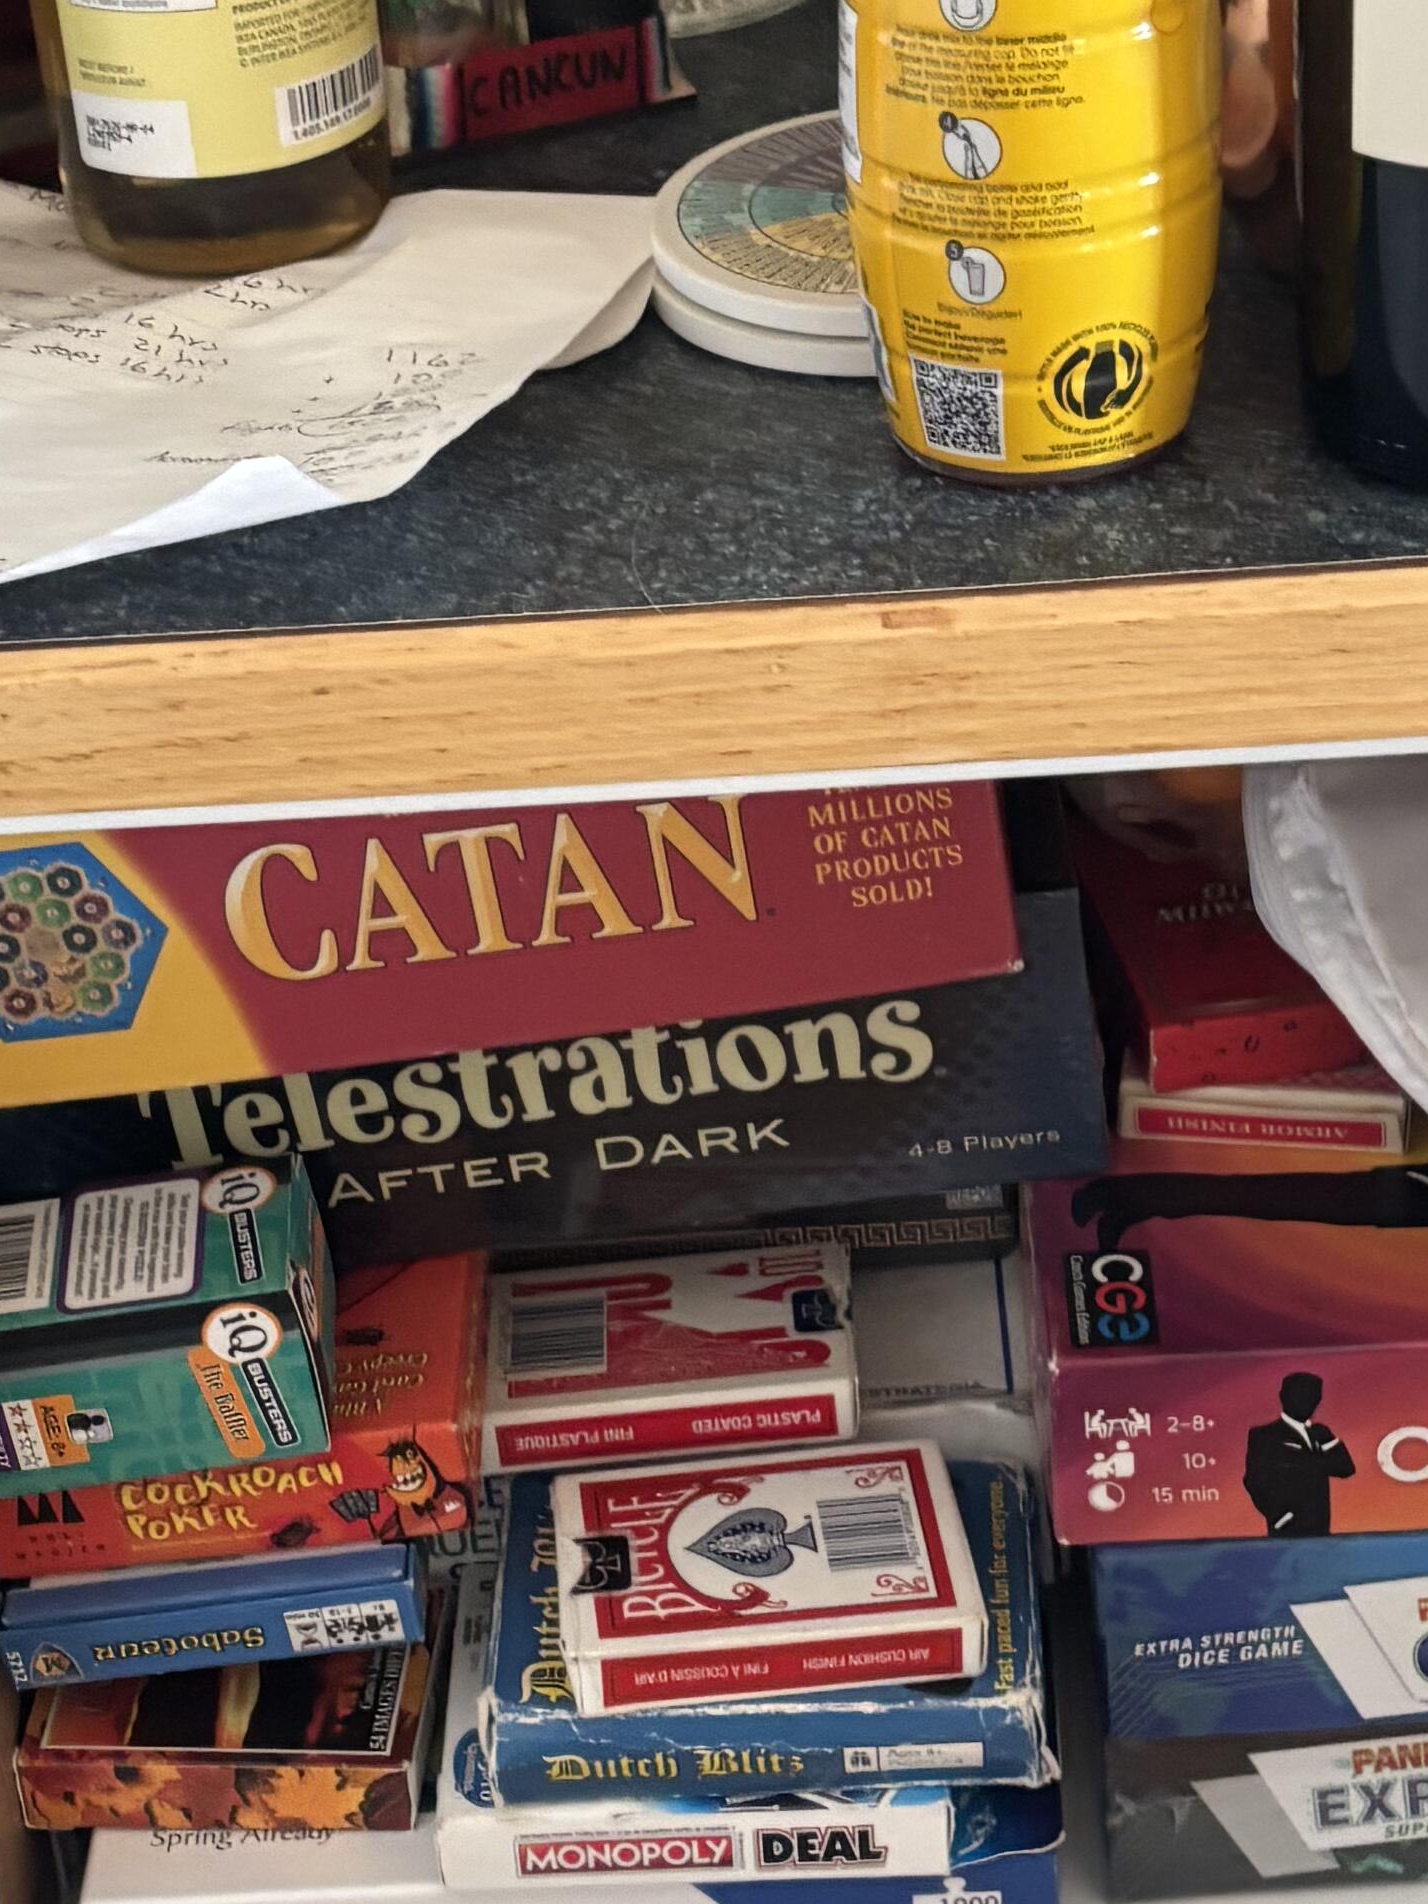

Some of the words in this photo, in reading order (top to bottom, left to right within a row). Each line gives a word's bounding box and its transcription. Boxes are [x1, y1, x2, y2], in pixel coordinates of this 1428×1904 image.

[471, 46, 628, 118] CANCUN
[808, 787, 953, 828] MILLIONS
[813, 831, 847, 855] OF
[861, 816, 952, 849] CATAN
[815, 844, 963, 885] PRODUCTS
[223, 795, 760, 984] CATAN
[851, 879, 933, 908] SOLD!
[139, 998, 936, 1170] Telestrations
[1165, 1115, 1250, 1135] FINISH
[1258, 1121, 1349, 1139] ARMOR
[909, 1139, 953, 1160] 4-8
[964, 1128, 1061, 1154] Players
[326, 1151, 553, 1209] AFTER
[597, 1118, 791, 1173] DARK
[234, 1211, 261, 1282] BUSTERS
[221, 1310, 269, 1358] iQ
[247, 1362, 296, 1446] BUSTERS
[756, 1408, 821, 1430] PLASTIC
[513, 1429, 598, 1451] PLASTIQUE
[602, 1425, 634, 1442] FINI
[691, 1414, 752, 1435] COATED
[1166, 1412, 1216, 1435] 2-8+
[1182, 1450, 1217, 1471] 10+
[120, 1461, 343, 1512] COCKROACH
[1151, 1486, 1174, 1505] 15
[1180, 1482, 1221, 1504] min
[125, 1503, 260, 1542] POKER
[93, 1626, 265, 1667] Saboteur
[993, 1611, 1014, 1657] paced
[1134, 1637, 1193, 1658] EXTRA
[1200, 1624, 1296, 1648] STRENGTH
[803, 1654, 846, 1672] FINISH
[848, 1649, 904, 1669] CUSHION
[906, 1647, 931, 1665] AIR
[1177, 1646, 1230, 1669] DICE
[1239, 1639, 1304, 1662] GAME
[670, 1666, 728, 1684] COUSSIN
[375, 1677, 400, 1733] IMAGES
[543, 1749, 681, 1785] Dutch
[695, 1747, 805, 1780] Blitz
[150, 1827, 233, 1854] Spring
[524, 1836, 731, 1871] MONOPOLY
[761, 1828, 887, 1866] DEAL
